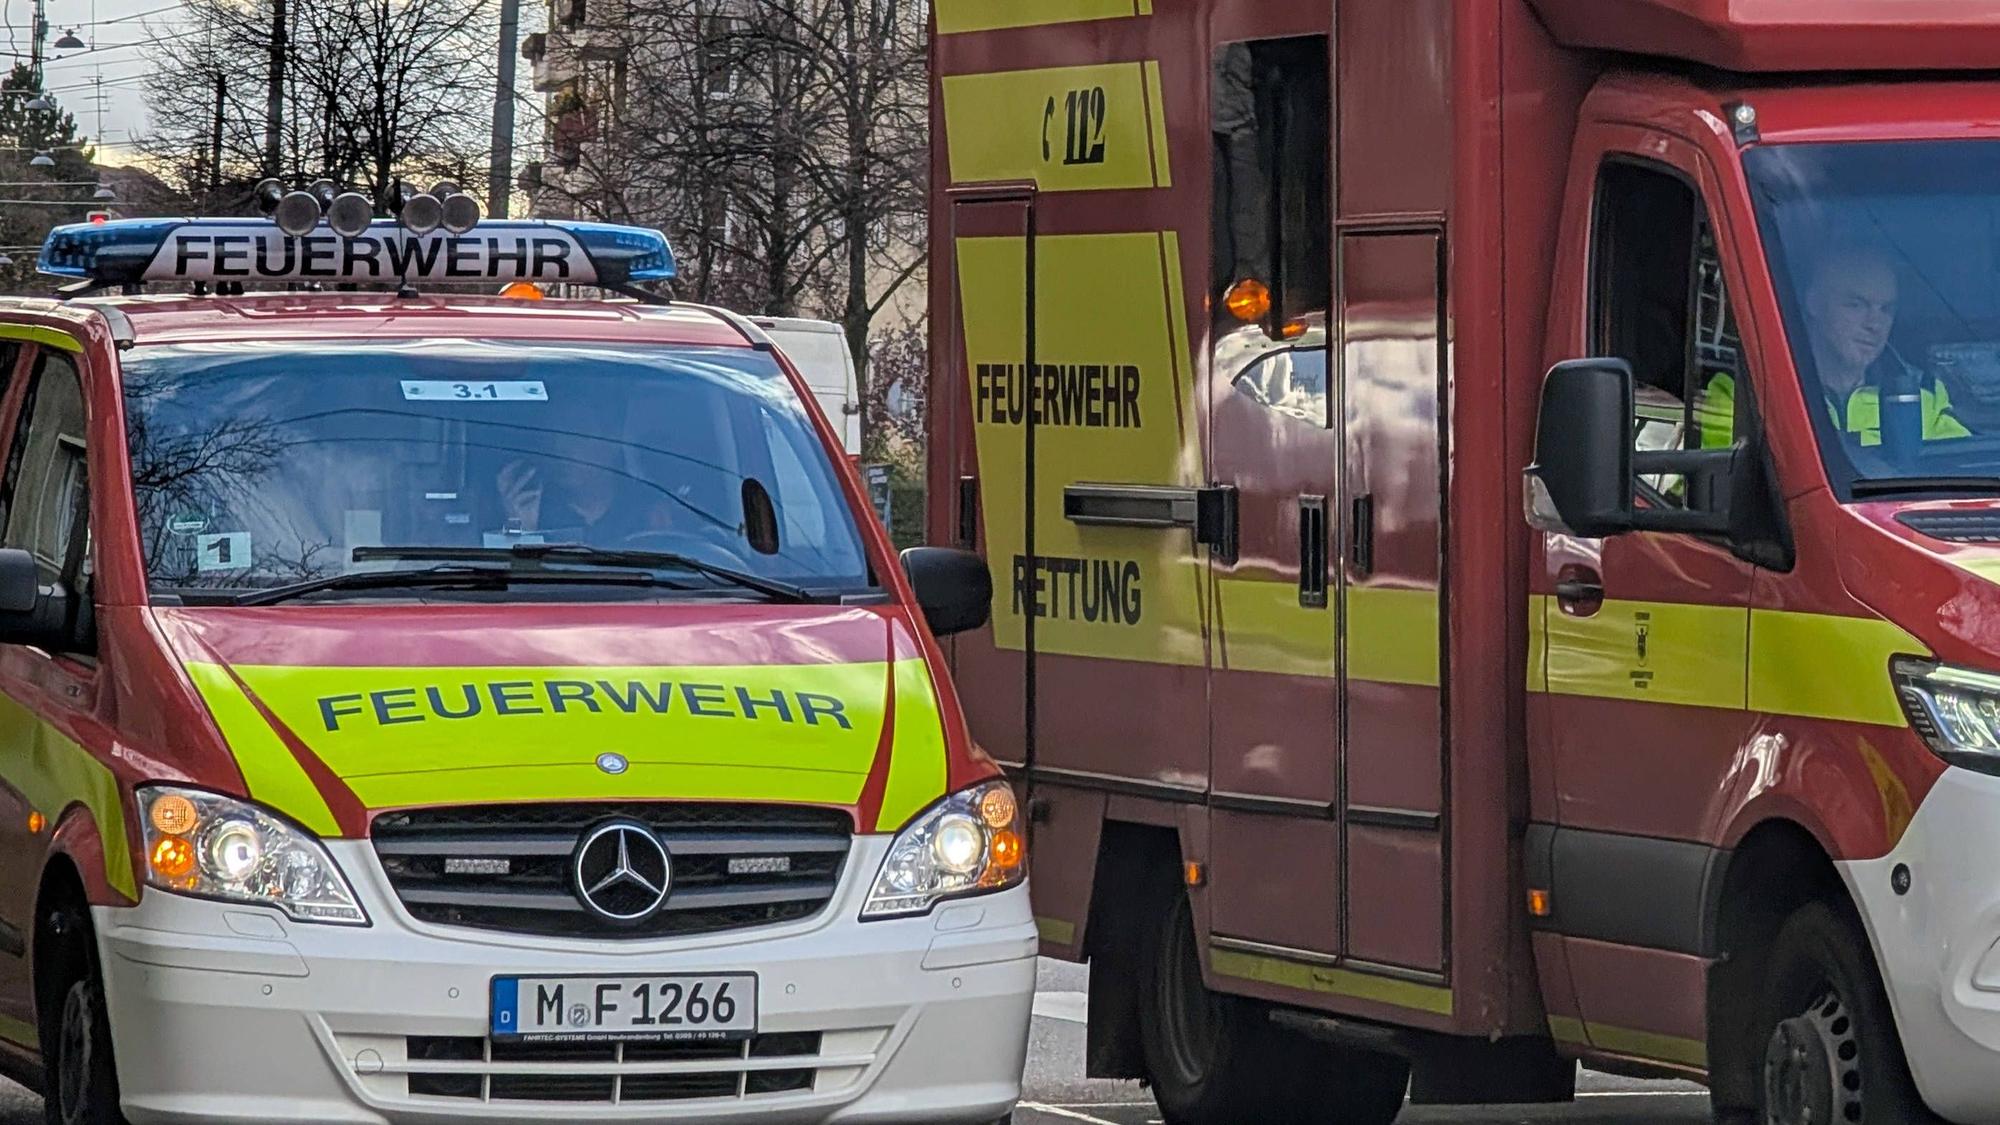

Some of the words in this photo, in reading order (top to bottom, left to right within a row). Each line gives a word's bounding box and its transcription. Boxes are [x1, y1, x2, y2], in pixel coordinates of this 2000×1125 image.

[1063, 86, 1106, 165] 112
[175, 236, 572, 278] FEUERWEHR
[452, 384, 498, 399] 3.1
[976, 364, 1142, 428] FEUERWEHR
[206, 537, 231, 563] 1
[1013, 554, 1142, 625] RETTUNG
[317, 680, 853, 731] FEUERWEHR
[500, 1010, 511, 1024] D
[537, 984, 564, 1025] M
[631, 982, 736, 1025] 1266
